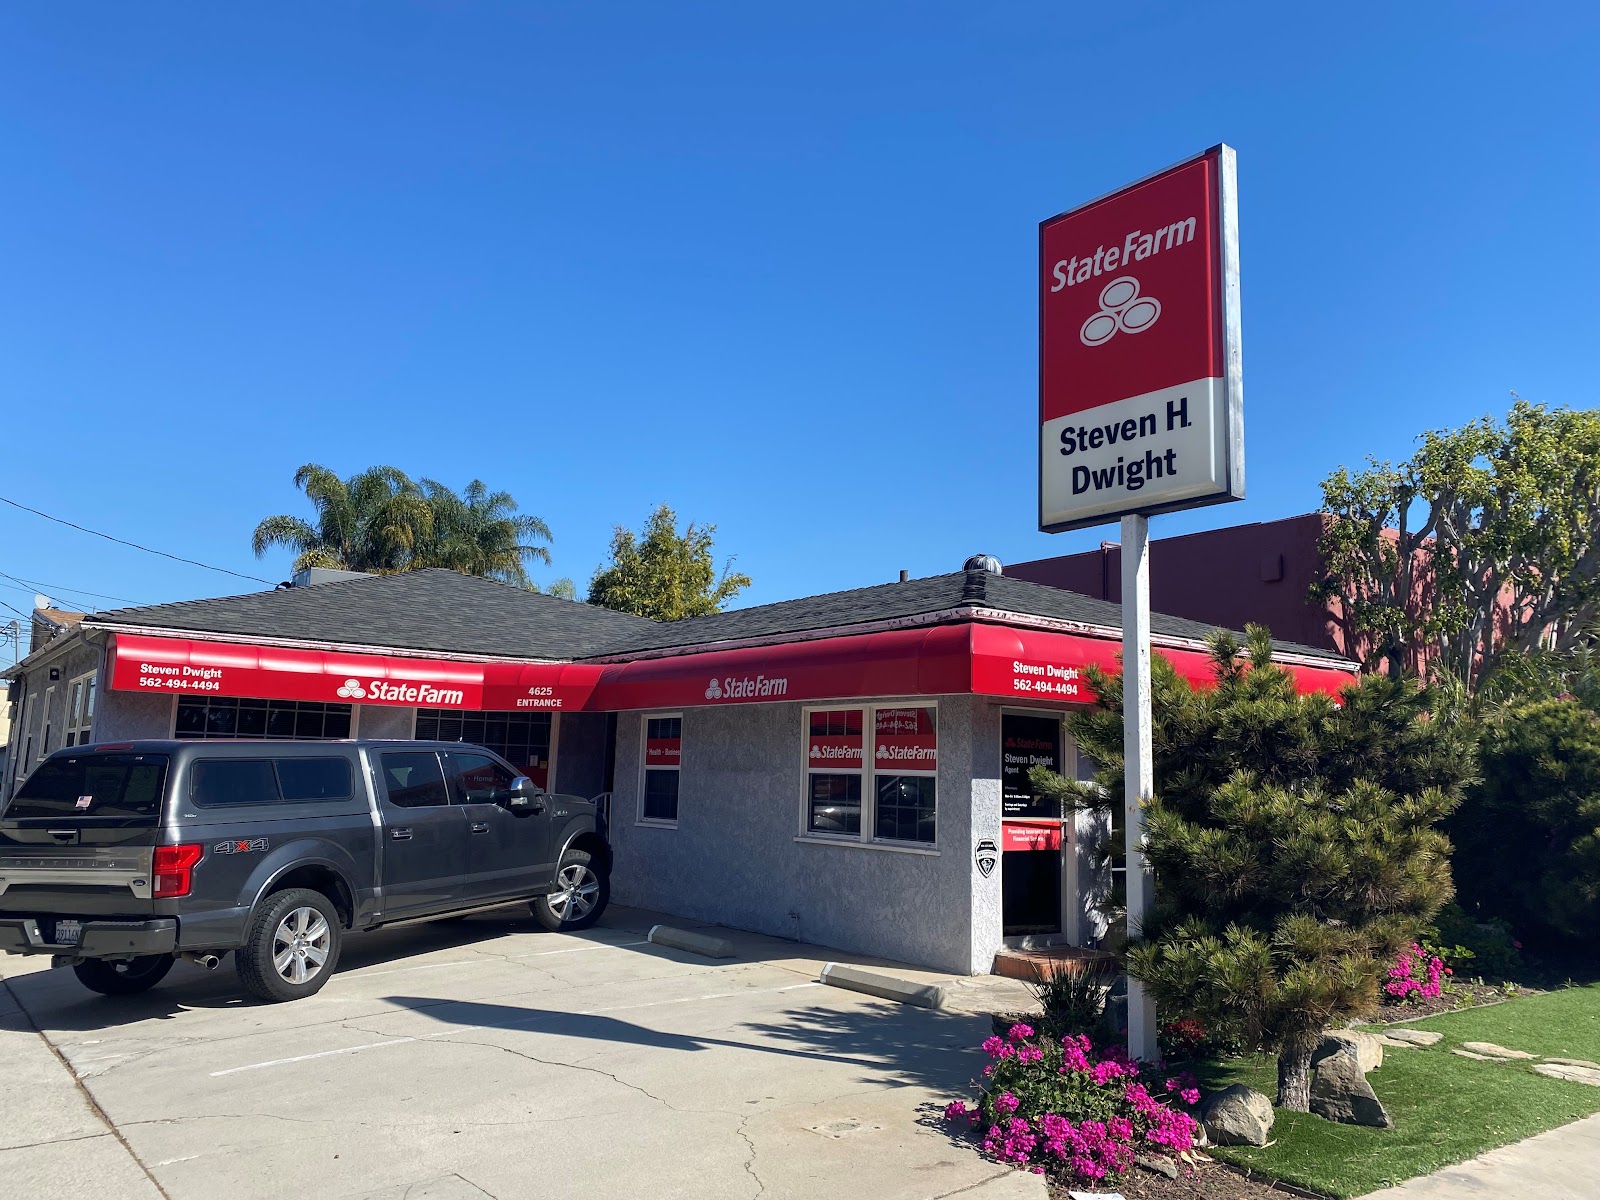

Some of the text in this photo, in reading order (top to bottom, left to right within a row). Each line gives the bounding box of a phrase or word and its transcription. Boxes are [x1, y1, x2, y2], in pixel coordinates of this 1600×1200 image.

[1060, 397, 1193, 456] Steven H.
[1071, 447, 1177, 495] Dwight
[139, 662, 223, 680] Steven Dwight
[1012, 660, 1079, 681] Steven Dwight
[139, 677, 220, 691] 562-494-4494
[528, 686, 553, 696] 4625
[1013, 678, 1078, 696] 562-494-4494
[516, 698, 562, 708] ENTRANCE
[1005, 753, 1053, 766] Steven Dwight
[1005, 766, 1019, 774] Agent
